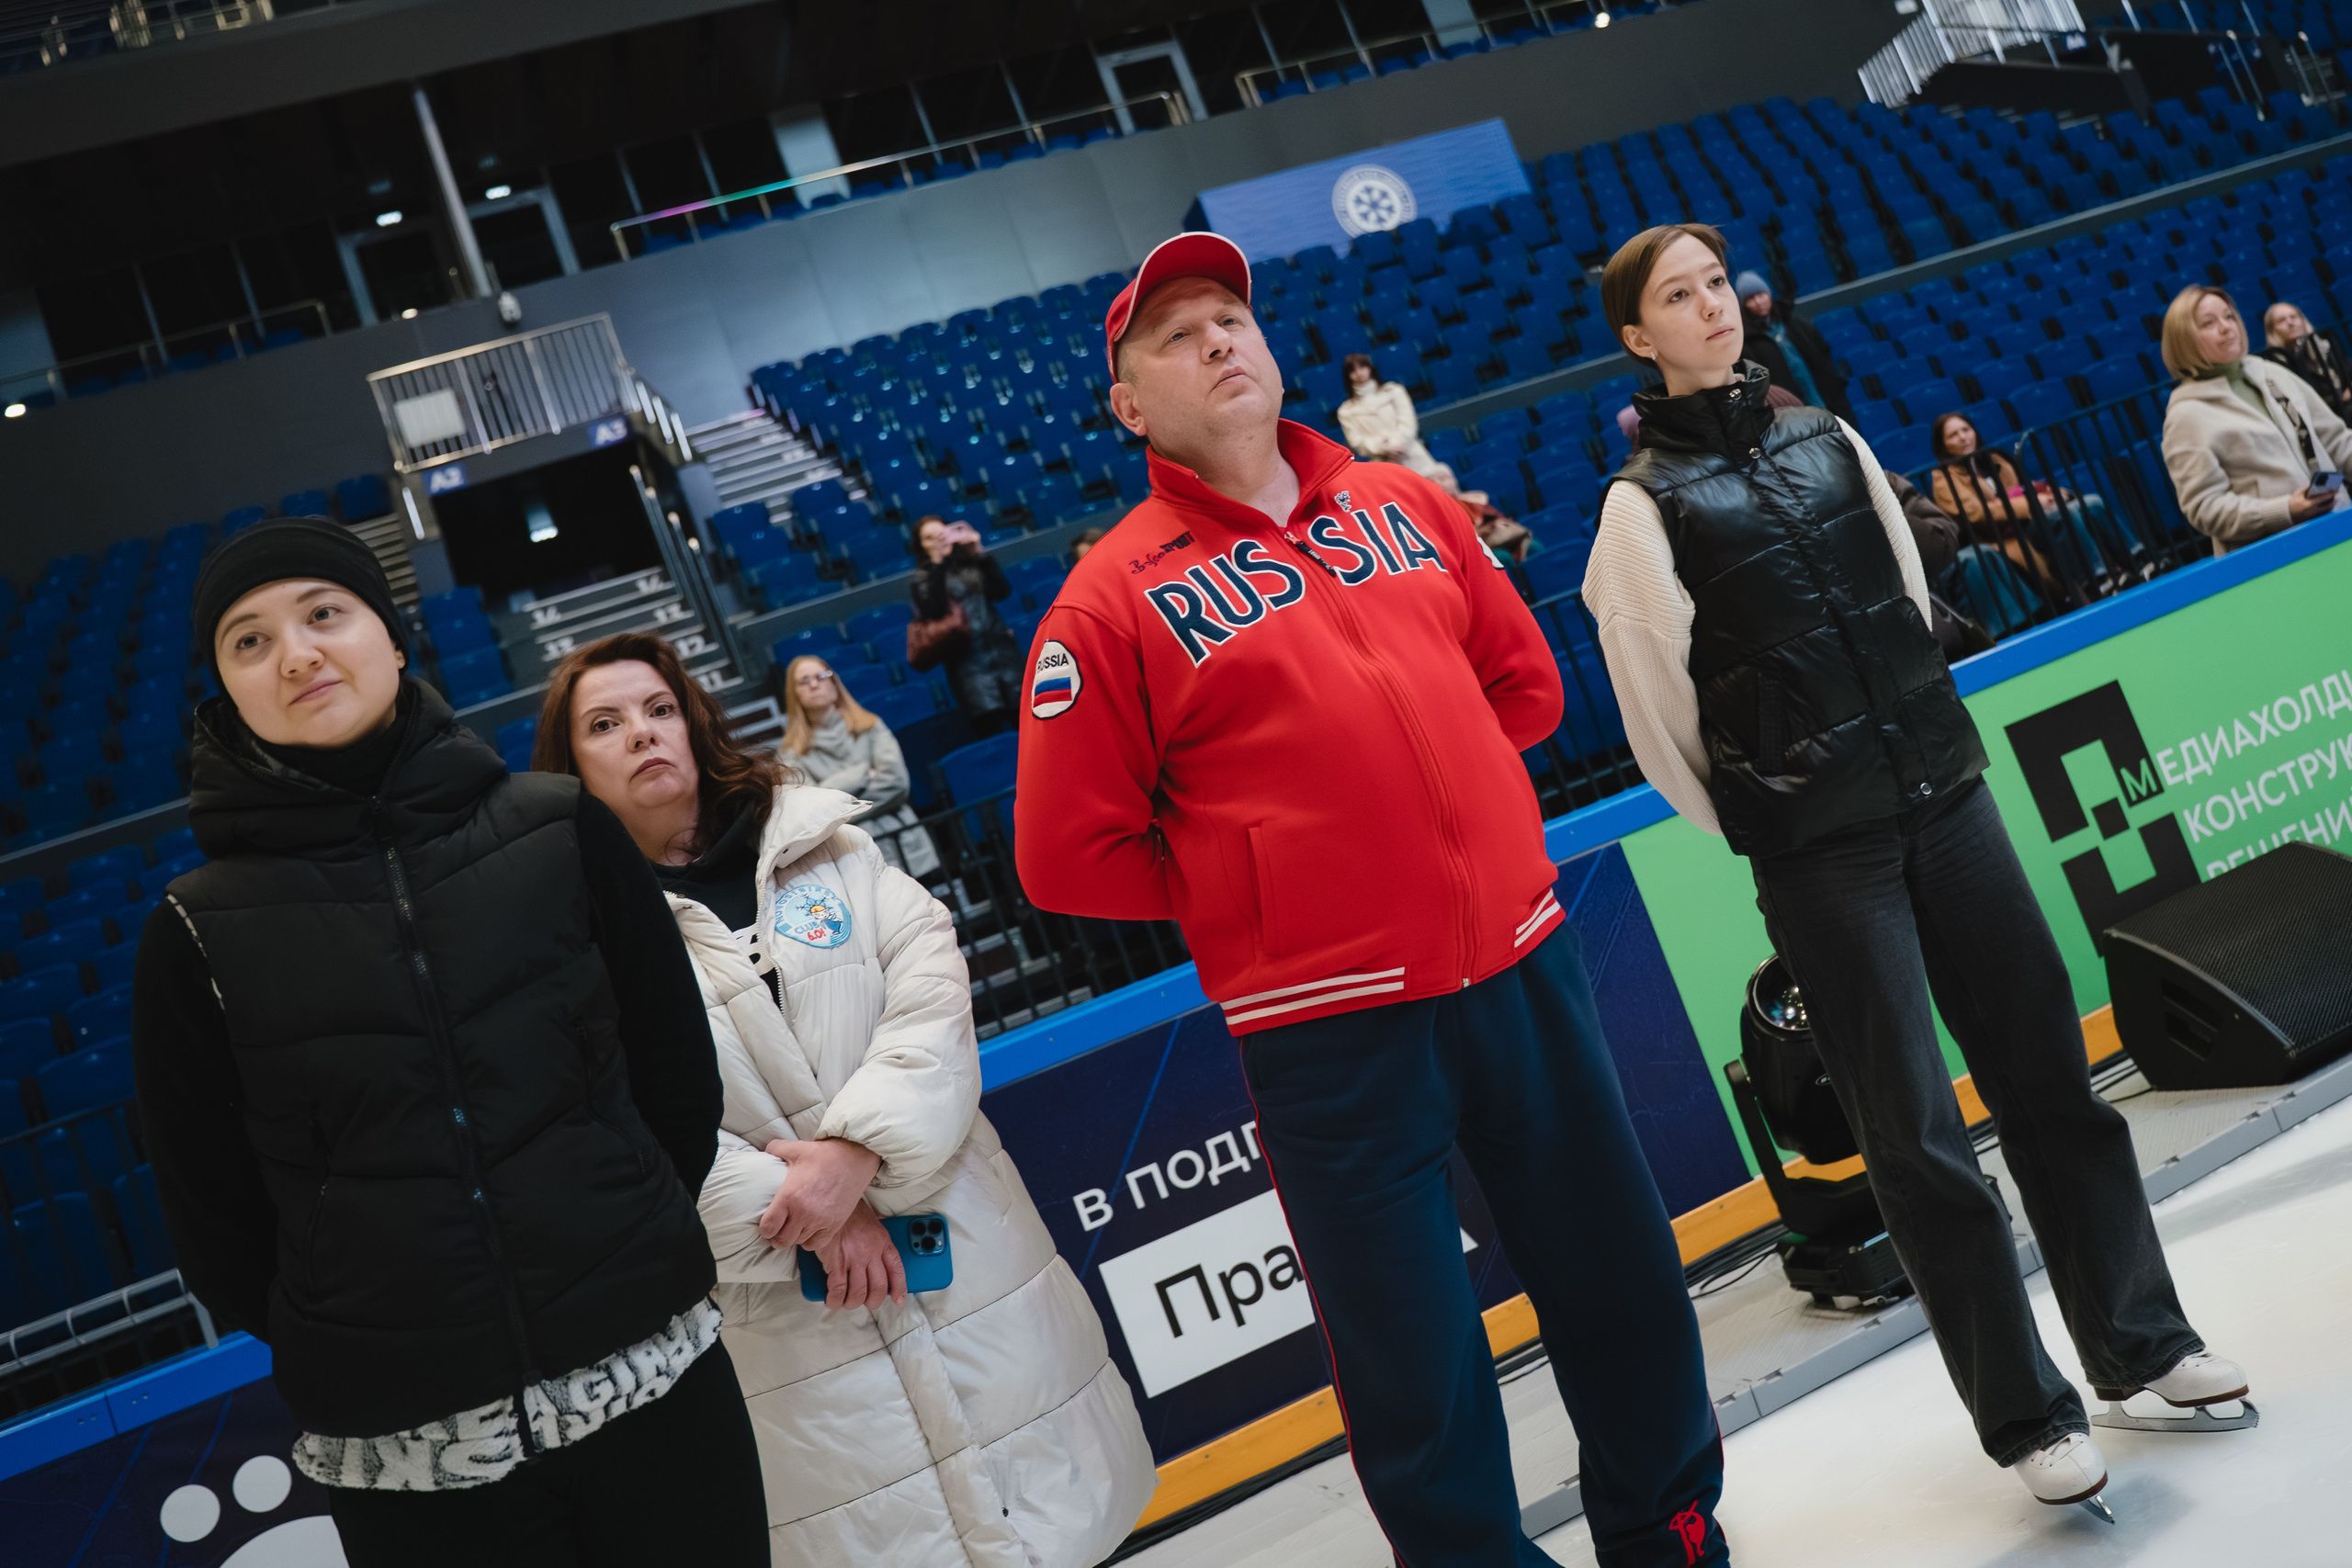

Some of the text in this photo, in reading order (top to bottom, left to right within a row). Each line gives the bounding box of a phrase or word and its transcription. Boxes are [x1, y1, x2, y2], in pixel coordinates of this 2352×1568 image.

[1144, 502, 1448, 668] RUSSIA
[1037, 653, 1069, 671] RUSSIA
[2120, 669, 2352, 802] МЕДИАХОЛД
[794, 921, 820, 935] CLUB
[1154, 1244, 1306, 1339] Пра
